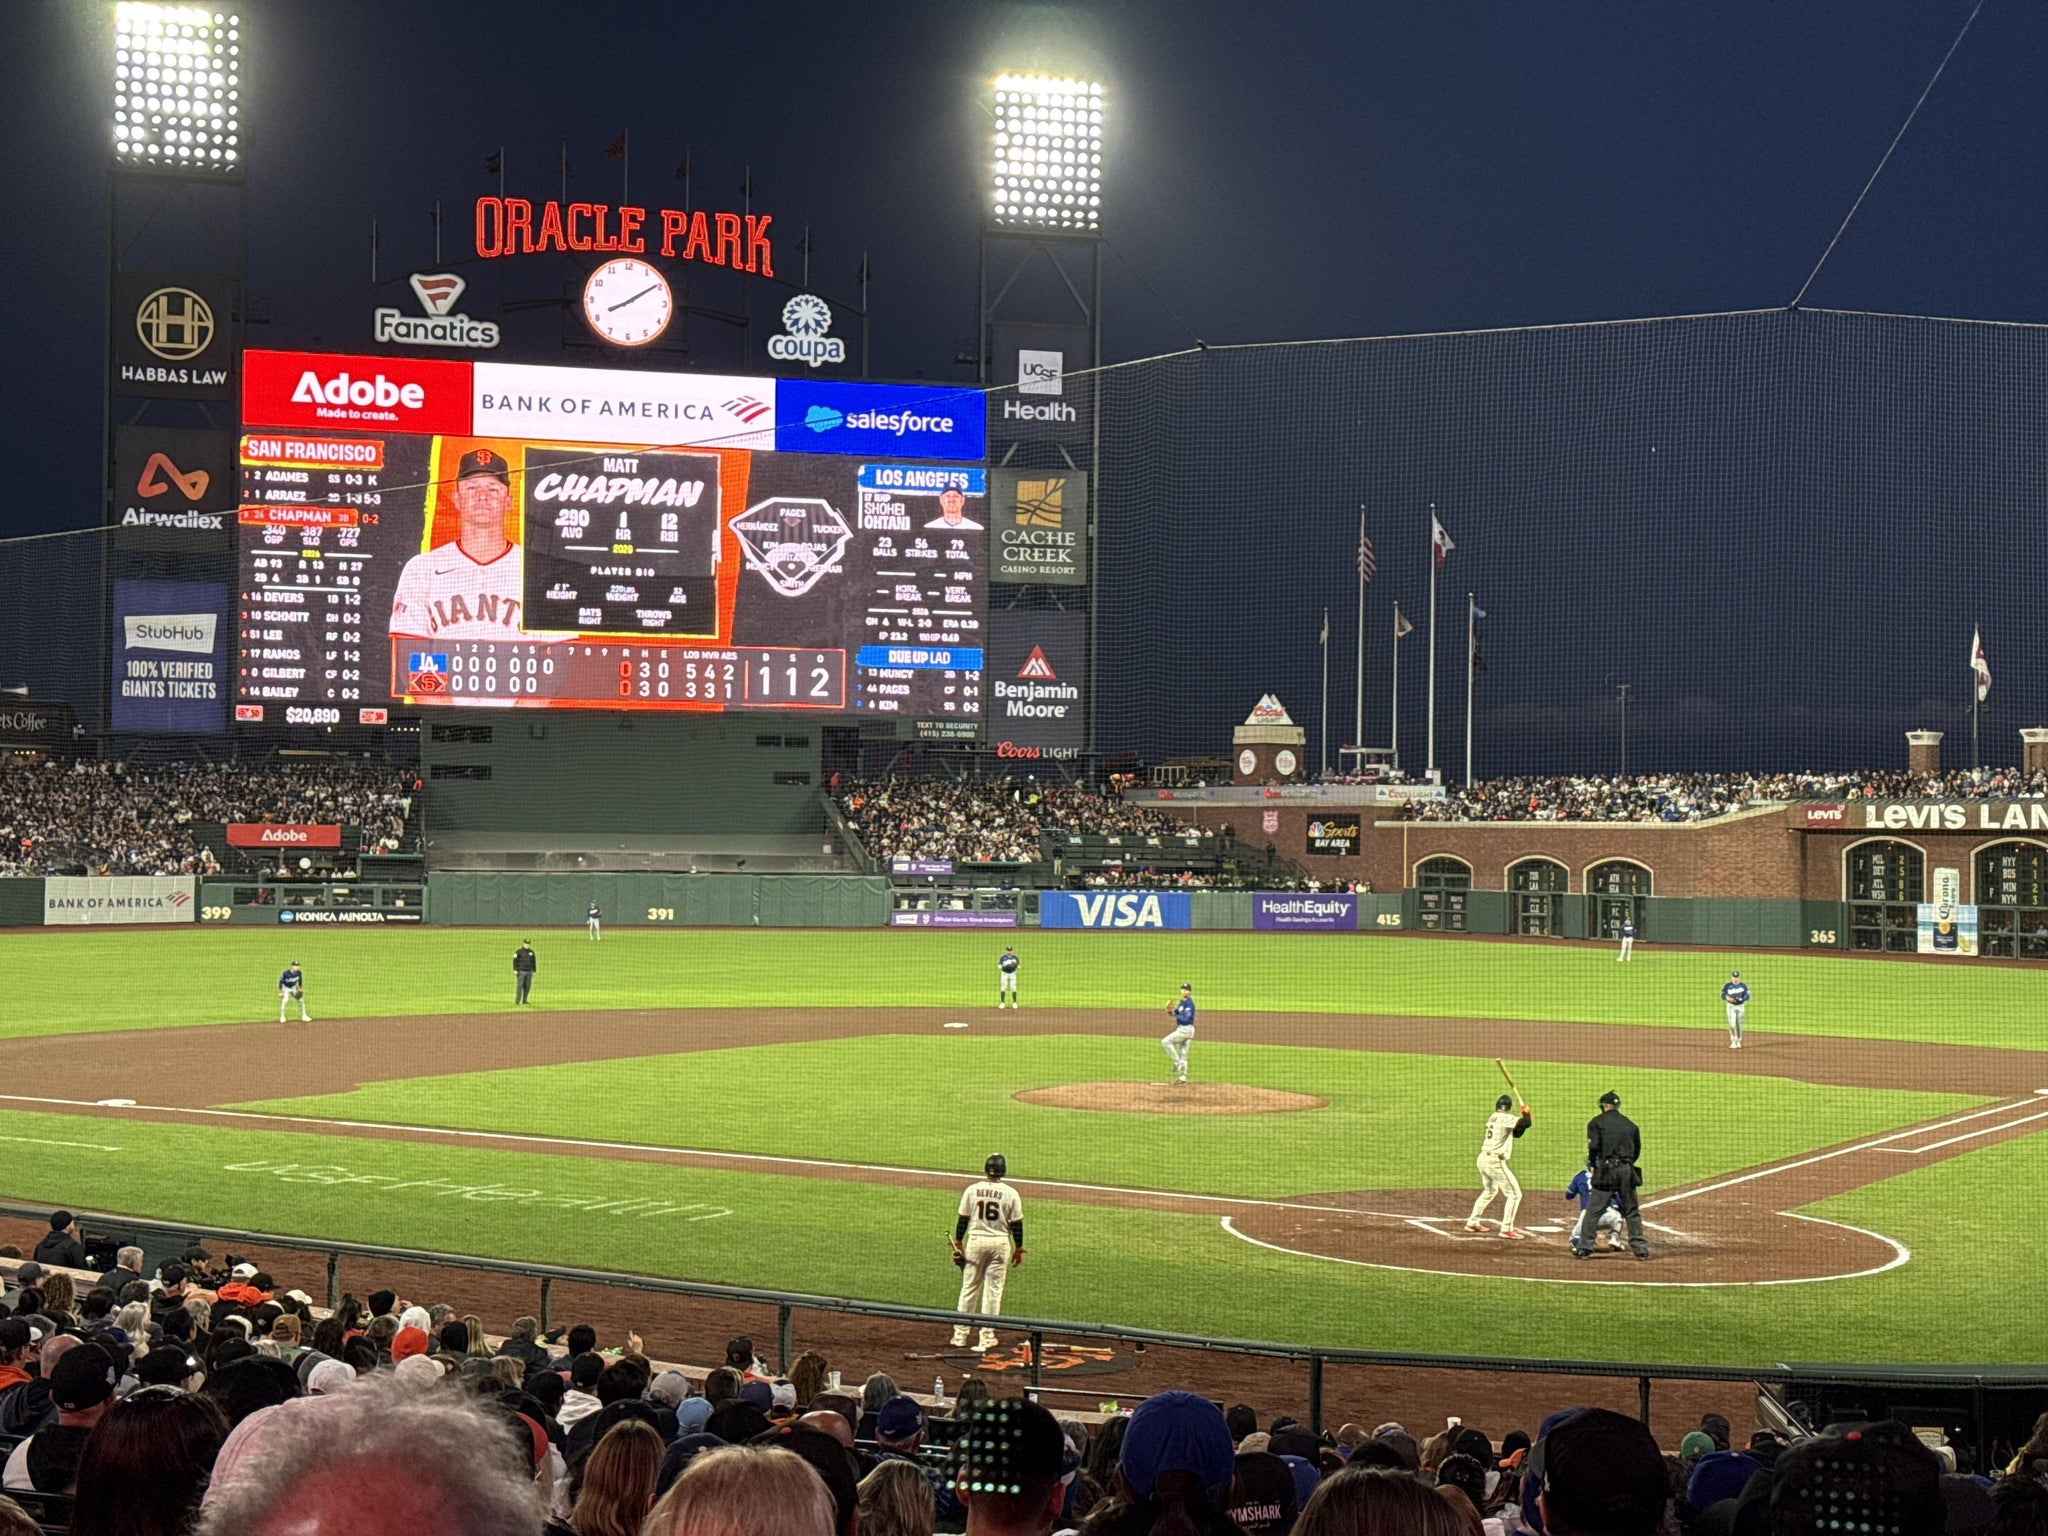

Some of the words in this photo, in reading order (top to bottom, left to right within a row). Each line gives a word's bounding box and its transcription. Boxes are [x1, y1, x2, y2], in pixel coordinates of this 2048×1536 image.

[473, 196, 646, 257] ORACLE
[660, 209, 775, 278] PARK
[379, 311, 496, 344] Fanatics
[771, 339, 842, 362] coupa
[122, 366, 188, 383] HABBAS
[192, 369, 227, 386] LAW
[1023, 363, 1058, 381] UCSF
[290, 371, 425, 409] Adobe
[316, 408, 347, 418] Made
[348, 410, 360, 419] to
[362, 411, 398, 421] create.
[482, 394, 552, 413] BANK
[560, 398, 592, 414] OF
[600, 401, 714, 422] AMERICA
[1003, 400, 1076, 421] Health
[846, 409, 953, 435] salesforce
[248, 439, 282, 458] SAN
[285, 441, 377, 462] FRANCISCO
[603, 457, 640, 473] MATT
[265, 471, 309, 483] ADAMES
[345, 473, 363, 485] 0-3
[368, 475, 378, 486] K
[875, 468, 903, 486] LOS
[904, 470, 969, 490] ANGELES
[265, 489, 306, 502] ARRAEZ
[534, 473, 705, 508] CHAPMAN
[864, 502, 905, 516] SHOHEI
[121, 508, 223, 530] Airwallex
[269, 510, 331, 522] CHAPMAN
[362, 514, 379, 525] 0-2
[554, 508, 590, 527] .290
[661, 513, 679, 530] 12
[864, 515, 911, 531] OHTANI
[337, 528, 361, 539] .727
[561, 527, 584, 539] AVG
[616, 528, 631, 540] HR
[660, 530, 679, 542] RBI
[1001, 529, 1076, 546] CACHE
[879, 537, 892, 548] 23
[915, 538, 928, 549] 56
[950, 540, 965, 550] 79
[873, 548, 898, 557] BALLS
[905, 549, 938, 558] STRIKES
[945, 550, 970, 560] TOTAL
[1003, 547, 1073, 563] CREEK
[590, 566, 632, 576] PLAYER
[1000, 565, 1037, 574] CASINO
[1039, 566, 1077, 575] RESORT
[264, 592, 304, 603] DEVERS
[345, 594, 360, 605] 1-2
[605, 592, 640, 602] WEIGHT
[264, 611, 310, 622] SCHMITT
[343, 613, 360, 624] 0-2
[425, 593, 521, 633] IANT
[135, 624, 204, 640] StubHub
[263, 630, 283, 640] LEE
[343, 632, 360, 643] 0-2
[263, 649, 301, 660] RAMOS
[344, 651, 360, 662] 1-2
[888, 650, 911, 664] DUE
[912, 651, 929, 664] UP
[930, 651, 951, 665] LAD
[126, 660, 158, 678] 100%
[161, 660, 213, 679] VERIFIED
[262, 668, 306, 679] GILBERT
[342, 669, 360, 680] 0-2
[452, 656, 463, 673] 0
[469, 656, 480, 673] 0
[486, 656, 497, 673] 0
[509, 657, 521, 674] 0
[526, 658, 537, 675] 0
[542, 658, 554, 675] 0
[639, 662, 650, 679] 3
[657, 662, 669, 679] 0
[686, 663, 697, 680] 5
[703, 664, 716, 680] 4
[723, 664, 735, 681] 2
[879, 669, 914, 679] MUNCY
[964, 670, 980, 681] 1-2
[452, 674, 463, 692] 0
[469, 675, 480, 692] 0
[486, 676, 497, 692] 0
[509, 676, 521, 693] 0
[526, 677, 537, 693] 0
[639, 681, 650, 698] 3
[657, 681, 669, 698] 0
[686, 682, 697, 699] 3
[704, 683, 715, 699] 3
[724, 683, 732, 699] 1
[759, 666, 770, 696] 1
[785, 667, 797, 697] 1
[809, 667, 830, 697] 2
[122, 680, 165, 698] GIANTS
[168, 682, 217, 699] TICKETS
[262, 687, 299, 698] BAILEY
[342, 688, 360, 699] 0-2
[879, 684, 910, 695] PAGES
[963, 686, 979, 697] 0-1
[994, 680, 1078, 702] Benjamin
[879, 700, 898, 711] KIM
[963, 702, 979, 713] 0-2
[1006, 700, 1066, 718] Moore
[13, 711, 48, 732] Coffee
[286, 706, 340, 724] $20,890
[916, 721, 934, 729] TEXT
[997, 741, 1041, 759] Coors
[1042, 747, 1080, 760] LIGHT
[1979, 803, 2048, 830] LAN
[260, 829, 308, 842] Adobe
[1323, 821, 1359, 839] Sports
[1314, 839, 1329, 848] BAY
[1329, 839, 1350, 848] AREA
[2001, 856, 2016, 867] NYY
[2002, 868, 2017, 879] BOS
[1608, 884, 1620, 893] SEA
[2002, 881, 2017, 892] MIN
[1871, 890, 1887, 900] WSH
[2001, 893, 2018, 905] NYM
[49, 898, 85, 909] BANK
[87, 898, 104, 909] OF
[106, 898, 163, 909] AMERICA
[1068, 894, 1163, 927] VISA
[1262, 899, 1349, 917] HealthEquity
[201, 907, 231, 920] 399
[295, 912, 338, 922] KONICA
[338, 912, 386, 922] MINOLTA
[647, 907, 675, 921] 391
[1376, 914, 1401, 926] 415
[1810, 930, 1836, 944] 365
[976, 1189, 1003, 1200] DEVERS
[977, 1200, 1000, 1221] 16
[1226, 1503, 1282, 1524] YMSHARK
